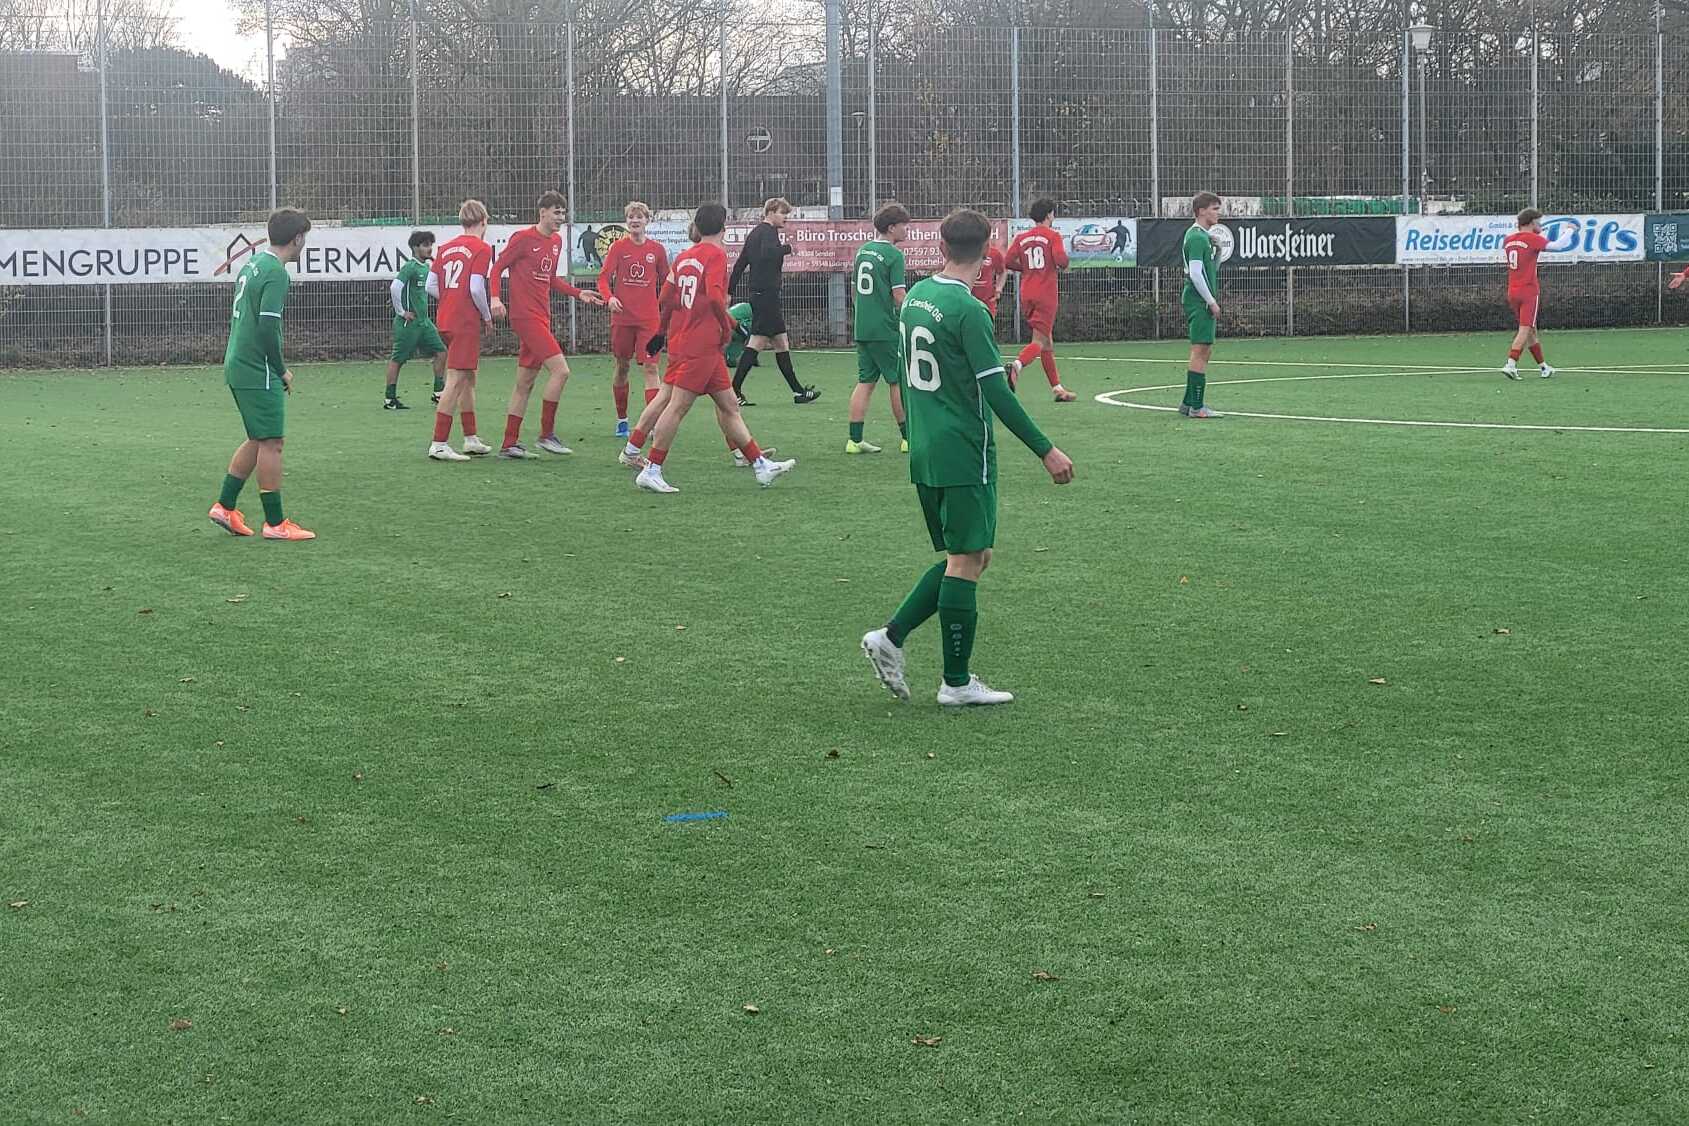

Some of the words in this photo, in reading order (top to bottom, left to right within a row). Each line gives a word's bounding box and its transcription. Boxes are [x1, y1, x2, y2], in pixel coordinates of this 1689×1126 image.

[796, 229, 825, 241] Büro
[827, 229, 877, 241] Troschel
[1239, 223, 1335, 262] Warsteiner
[1405, 228, 1506, 250] Reisedien
[1024, 246, 1045, 270] 18
[1509, 250, 1518, 269] 9
[443, 260, 464, 289] 12
[857, 261, 873, 295] 6
